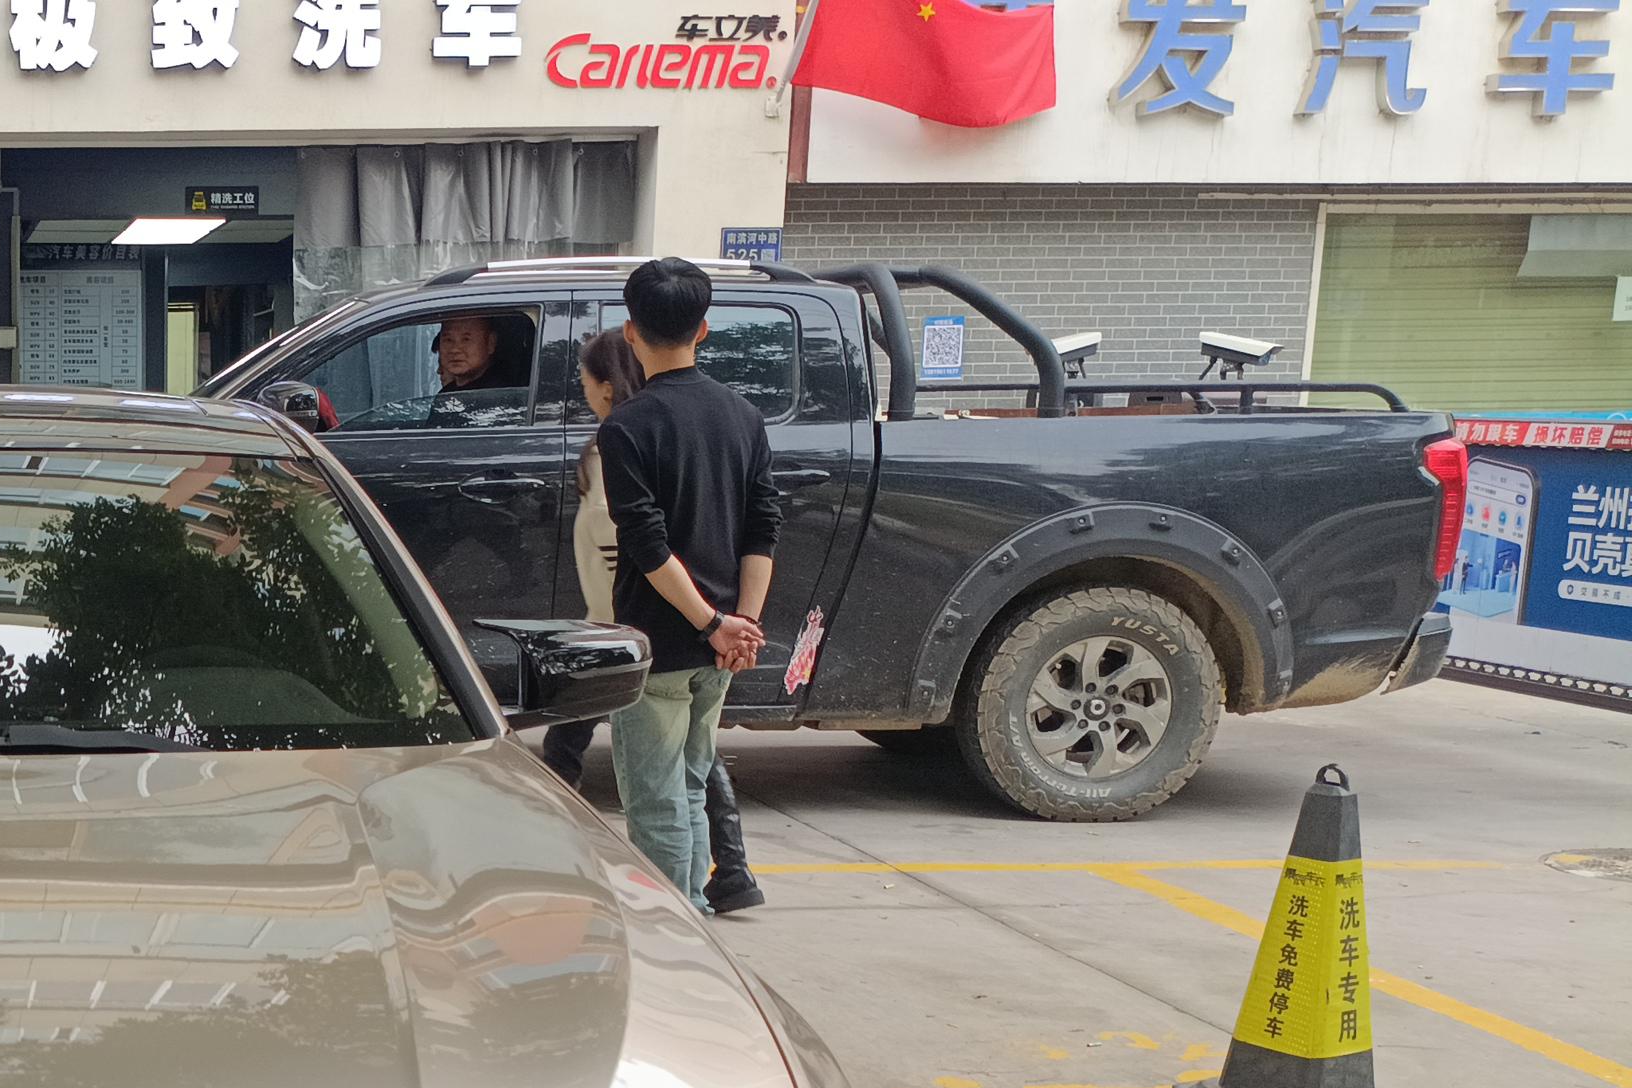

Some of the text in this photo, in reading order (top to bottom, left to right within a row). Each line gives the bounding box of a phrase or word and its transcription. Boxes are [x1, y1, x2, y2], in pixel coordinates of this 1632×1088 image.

[964, 0, 1621, 118] 发汽车
[210, 192, 255, 205] 精洗工位
[726, 232, 778, 245] 南滨河中路
[1535, 425, 1604, 446] 损坏赔偿
[1568, 484, 1632, 531] 兰州
[1110, 615, 1180, 657] YUSTA
[1264, 893, 1310, 1039] 洗车免费停车
[1338, 897, 1360, 1043] 洗车专用
